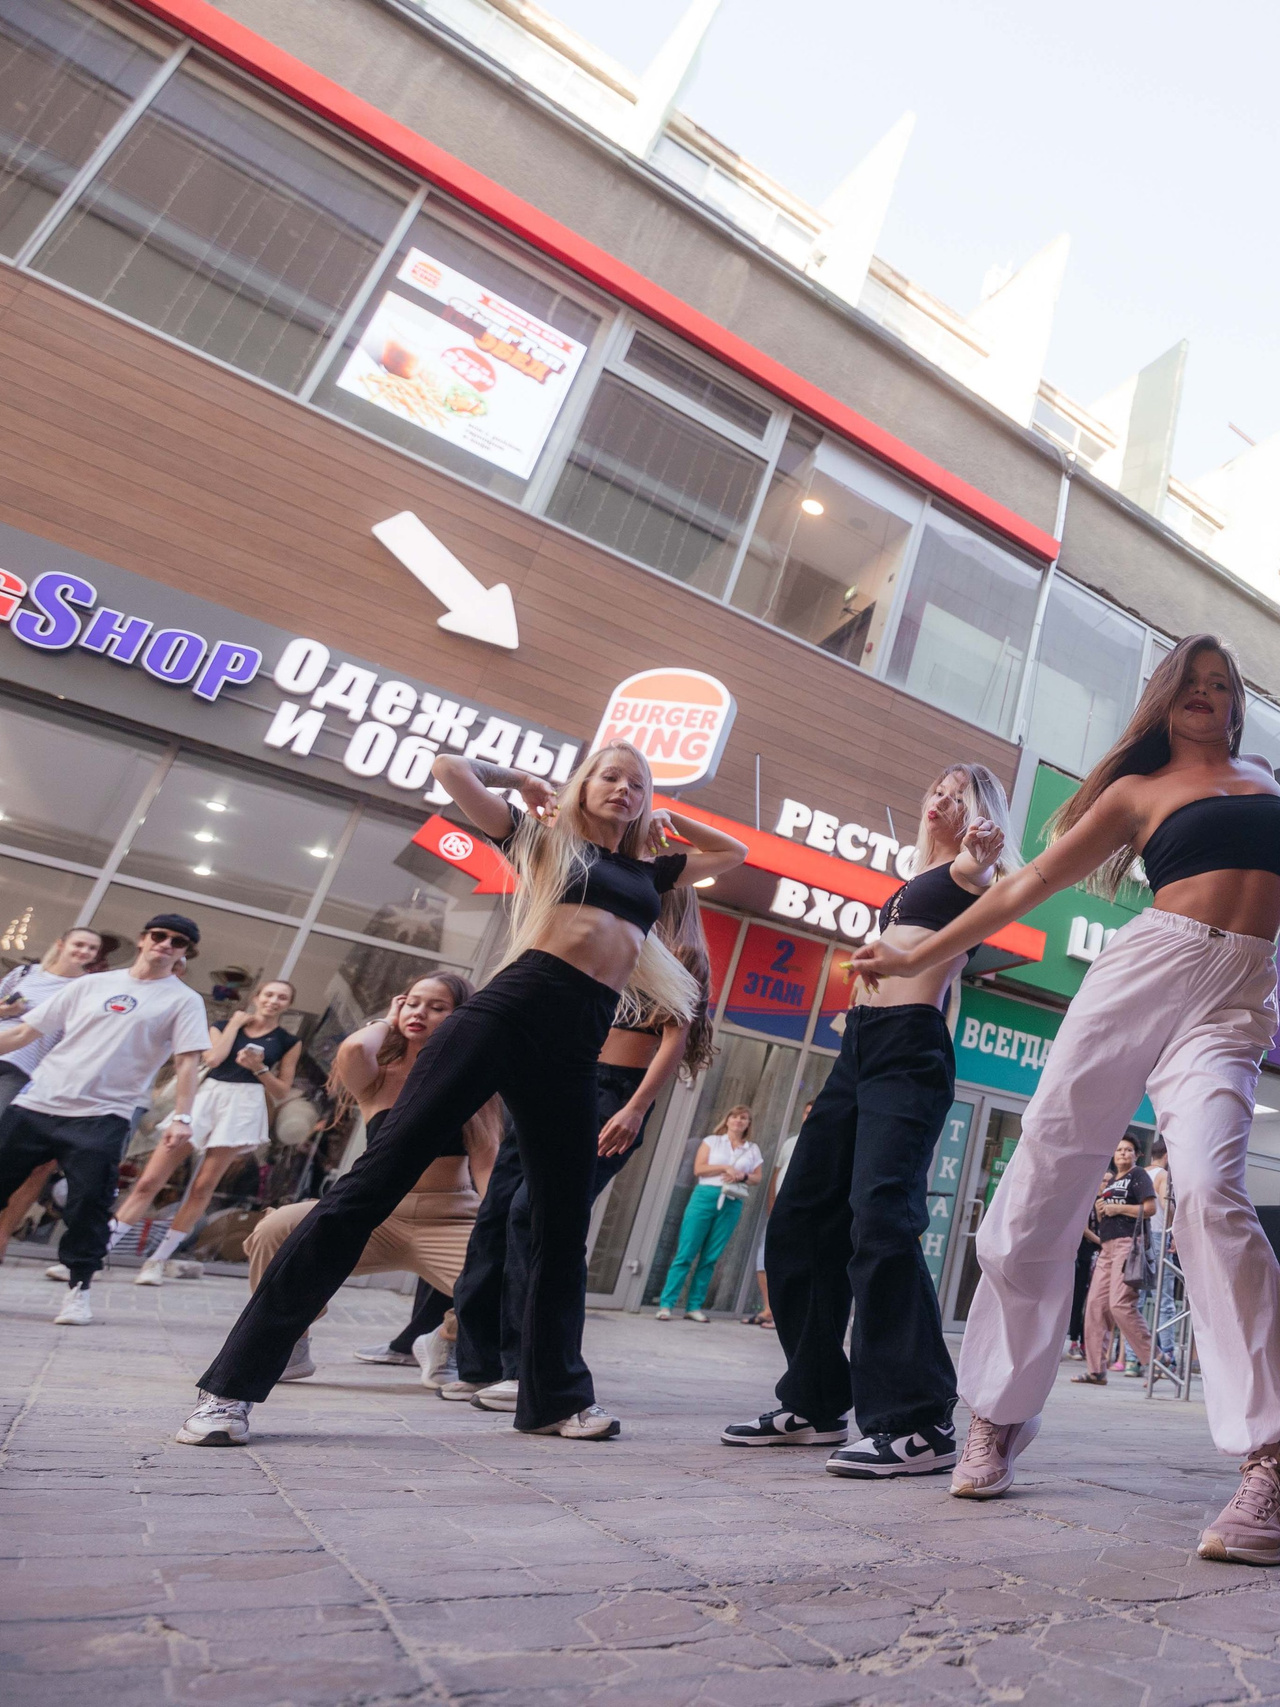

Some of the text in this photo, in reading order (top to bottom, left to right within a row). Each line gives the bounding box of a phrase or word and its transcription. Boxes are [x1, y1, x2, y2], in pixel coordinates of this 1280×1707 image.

[273, 638, 578, 783] Одежды
[610, 701, 719, 730] BURGER
[600, 723, 711, 761] KING
[774, 798, 920, 882] РЕСТО
[770, 939, 796, 974] 2
[743, 971, 806, 1007] ЭТАЖ
[961, 1016, 1055, 1070] ВСЕГДА
[922, 1119, 965, 1283] ТКАН
